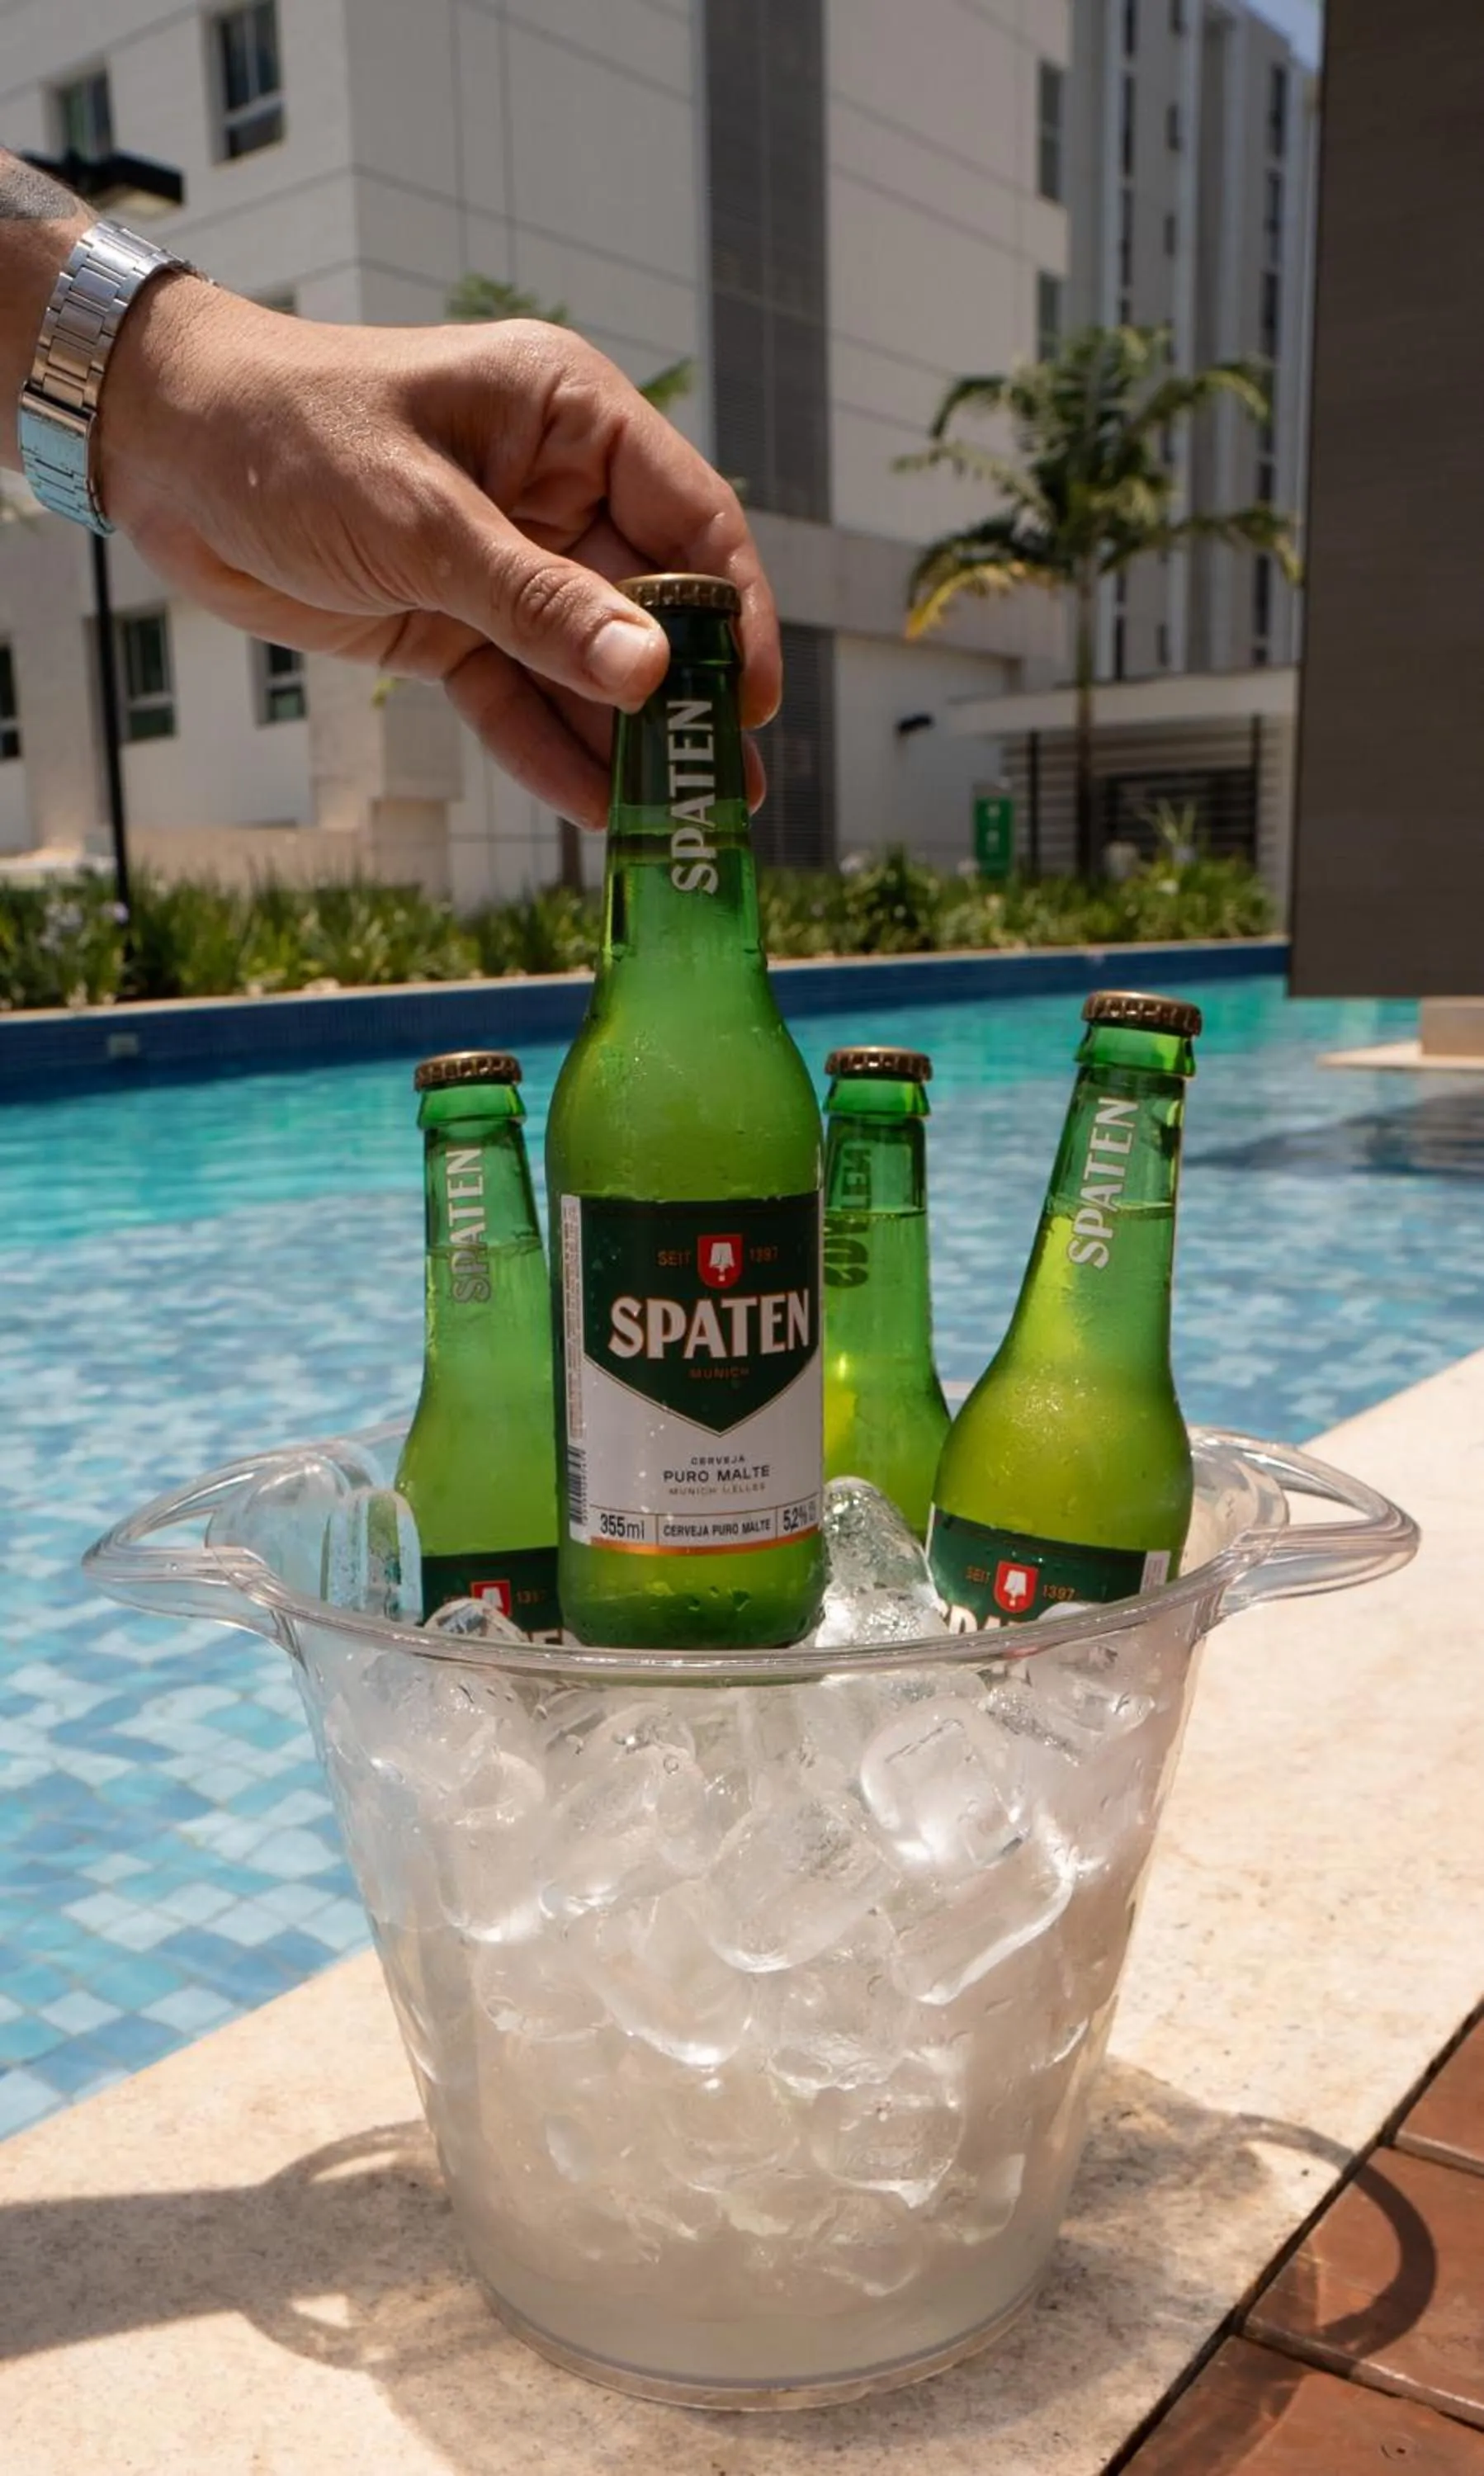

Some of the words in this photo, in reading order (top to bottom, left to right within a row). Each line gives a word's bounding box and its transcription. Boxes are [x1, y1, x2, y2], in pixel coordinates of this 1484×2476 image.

[667, 701, 719, 895] SPATEN
[1068, 1097, 1139, 1269] SPATEN
[446, 1148, 490, 1303] SPATEN
[607, 1288, 810, 1359] SPATEN
[663, 1470, 709, 1483] PURO
[717, 1465, 770, 1481] MALTE
[691, 1455, 745, 1466] CERVEJA
[600, 1513, 645, 1540] 355ml
[663, 1524, 709, 1538] CERVEJA
